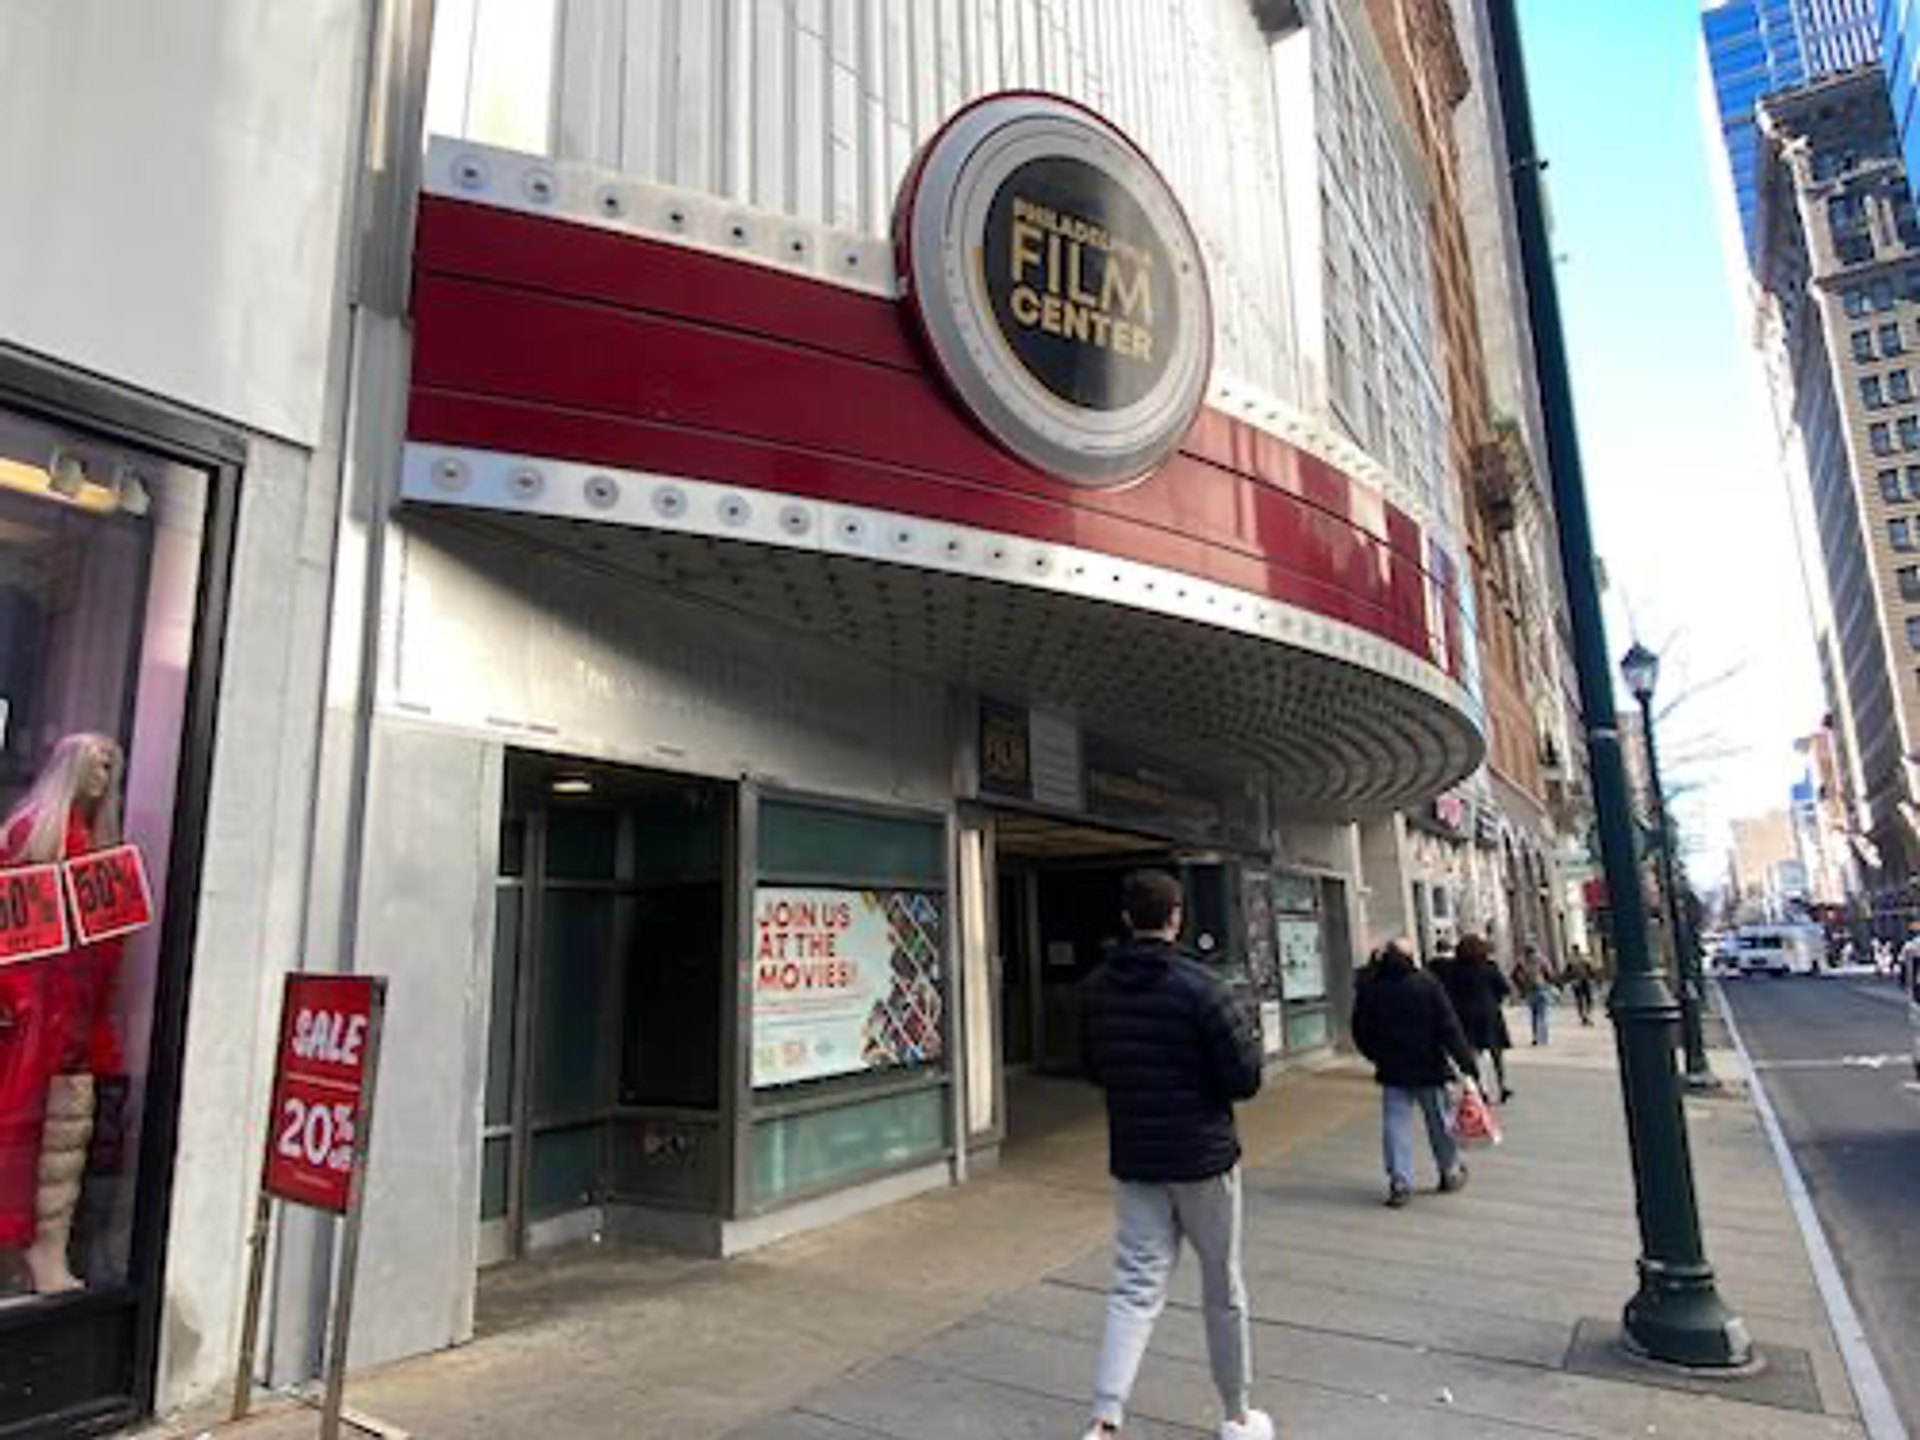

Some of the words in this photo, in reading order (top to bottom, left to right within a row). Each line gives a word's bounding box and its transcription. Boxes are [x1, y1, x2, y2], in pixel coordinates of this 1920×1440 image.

[1012, 222, 1153, 326] FILM
[1012, 286, 1153, 362] CENTER
[757, 901, 816, 929] JOIN
[821, 902, 851, 929] US
[757, 931, 789, 959] AT
[795, 931, 837, 958] THE
[292, 1008, 367, 1065] SALE
[278, 1098, 356, 1167] 20%
